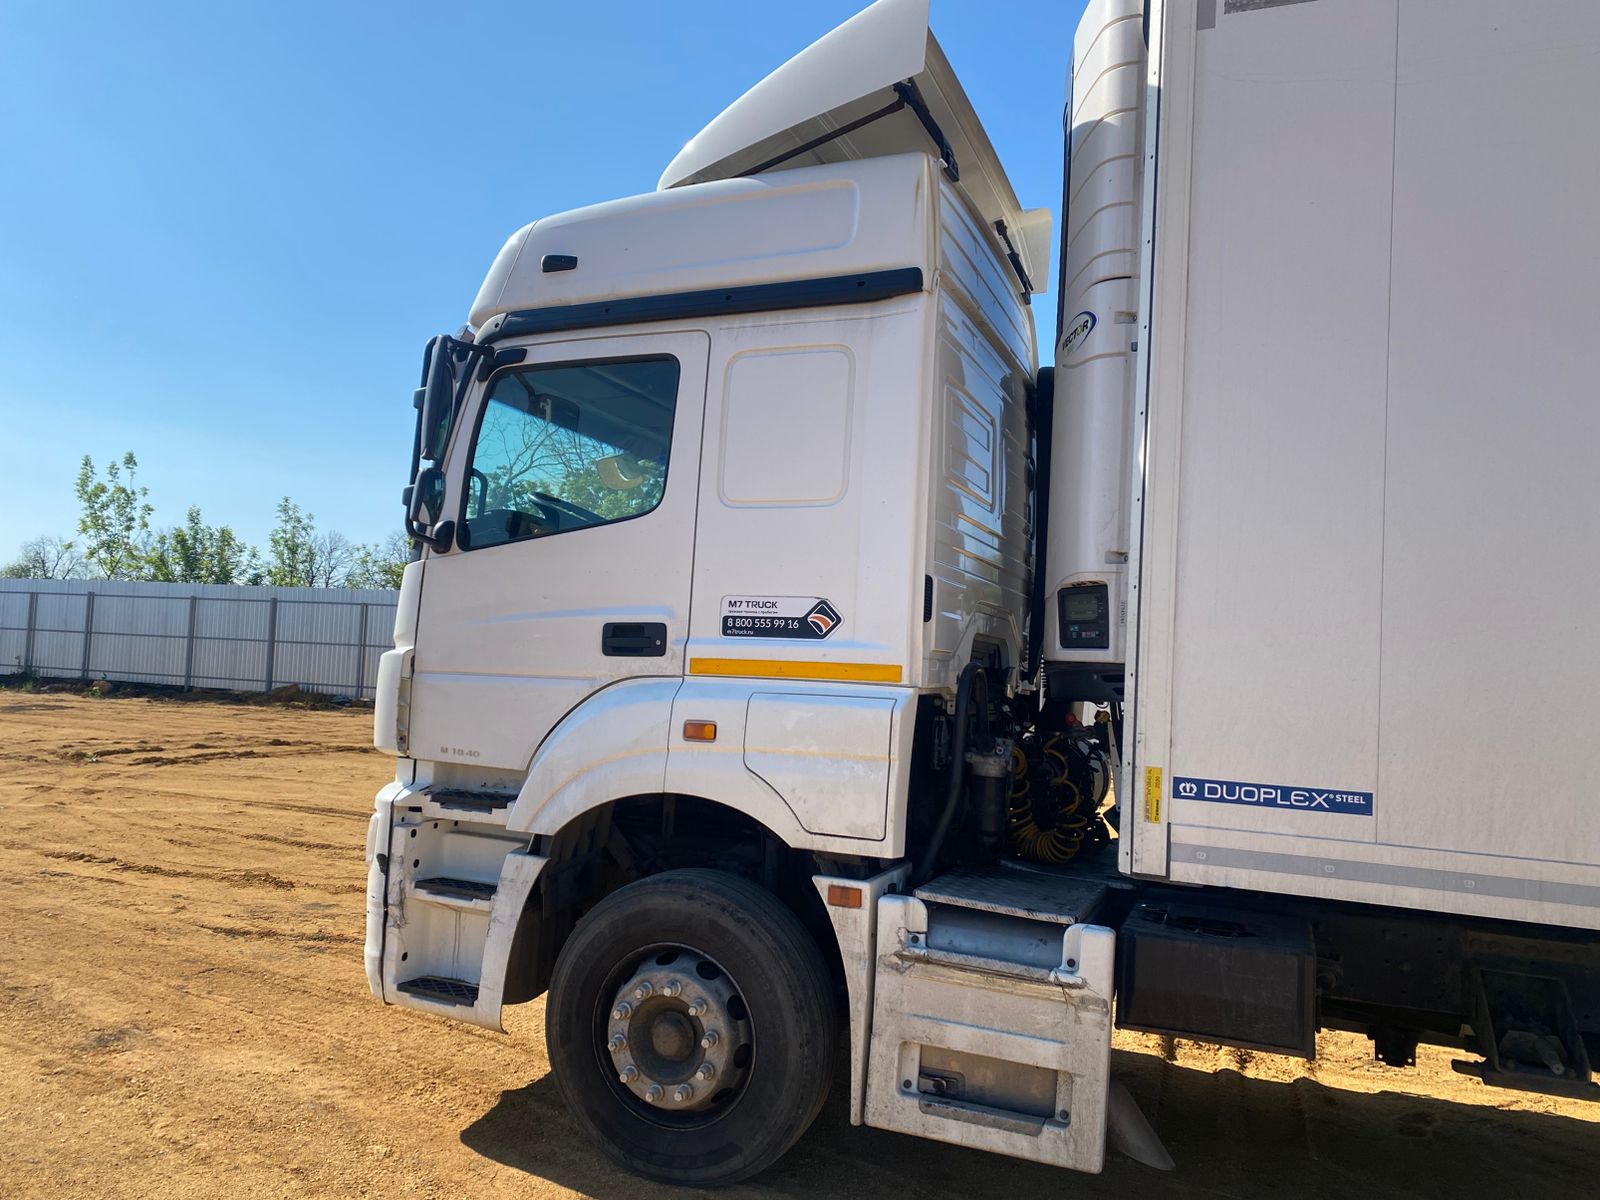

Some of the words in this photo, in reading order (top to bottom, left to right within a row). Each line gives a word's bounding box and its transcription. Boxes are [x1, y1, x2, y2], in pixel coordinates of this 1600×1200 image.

[728, 618, 733, 627] 8
[735, 618, 752, 627] 800
[754, 618, 771, 628] 555
[773, 620, 785, 628] 99
[788, 620, 799, 629] 16
[1335, 794, 1366, 804] STEEL
